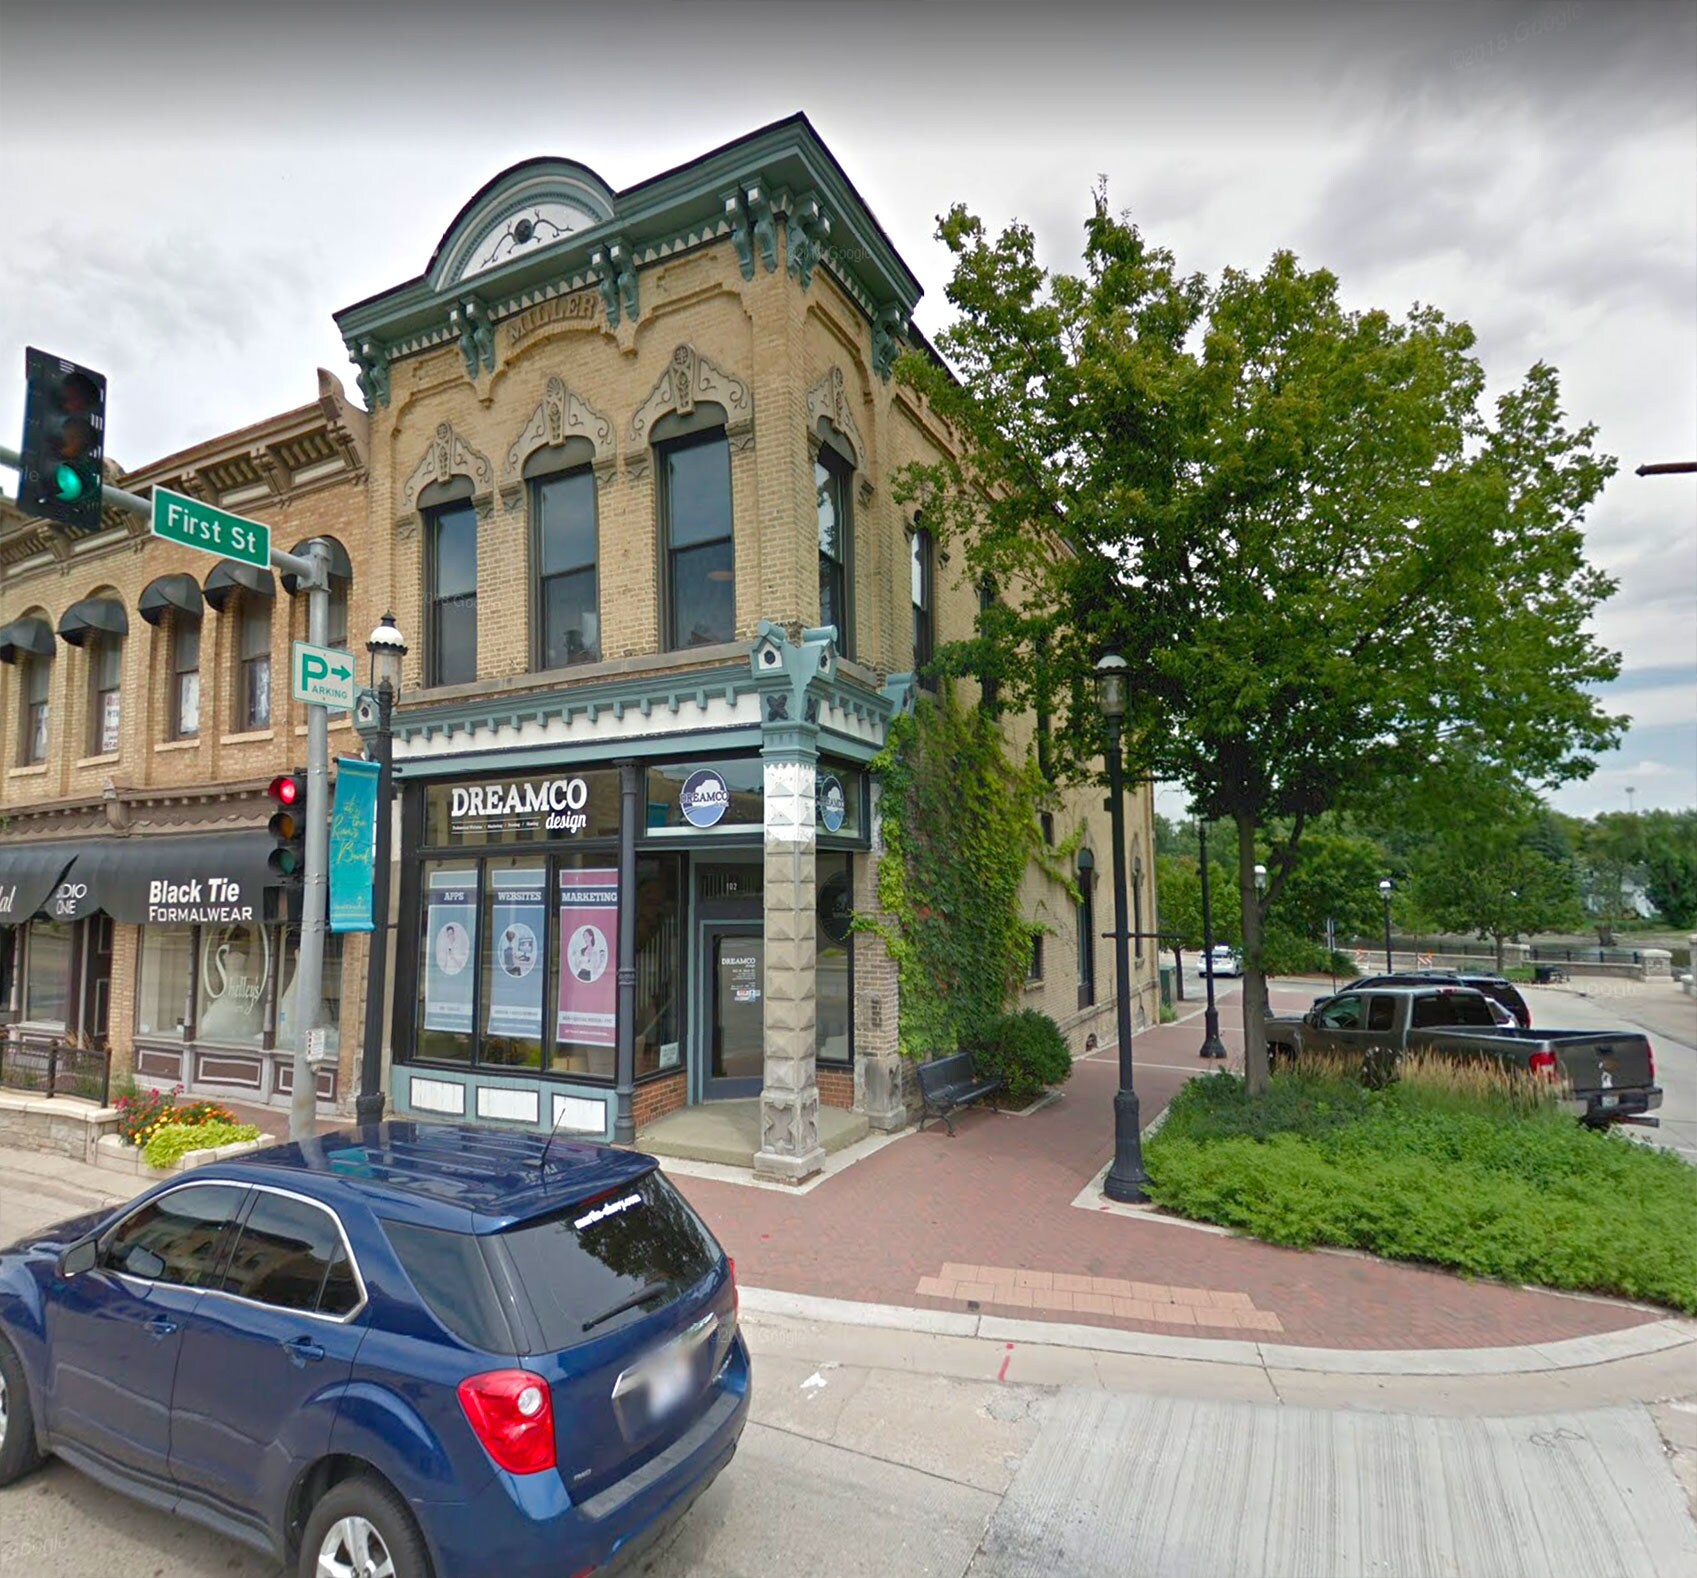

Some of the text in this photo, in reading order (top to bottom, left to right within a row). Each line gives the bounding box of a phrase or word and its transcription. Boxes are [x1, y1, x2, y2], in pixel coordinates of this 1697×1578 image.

[509, 292, 597, 344] MILLER
[168, 504, 257, 553] First St
[451, 779, 587, 817] DREAMCO
[679, 791, 729, 804] DREAMCO
[546, 811, 586, 834] design
[150, 878, 240, 904] Black Tie
[726, 882, 738, 891] 102
[443, 891, 464, 901] APPS
[497, 891, 542, 901] WEBSITES
[561, 892, 618, 902] MARKETING
[149, 906, 252, 922] FORMALWEAR
[721, 957, 757, 965] DREAMCO
